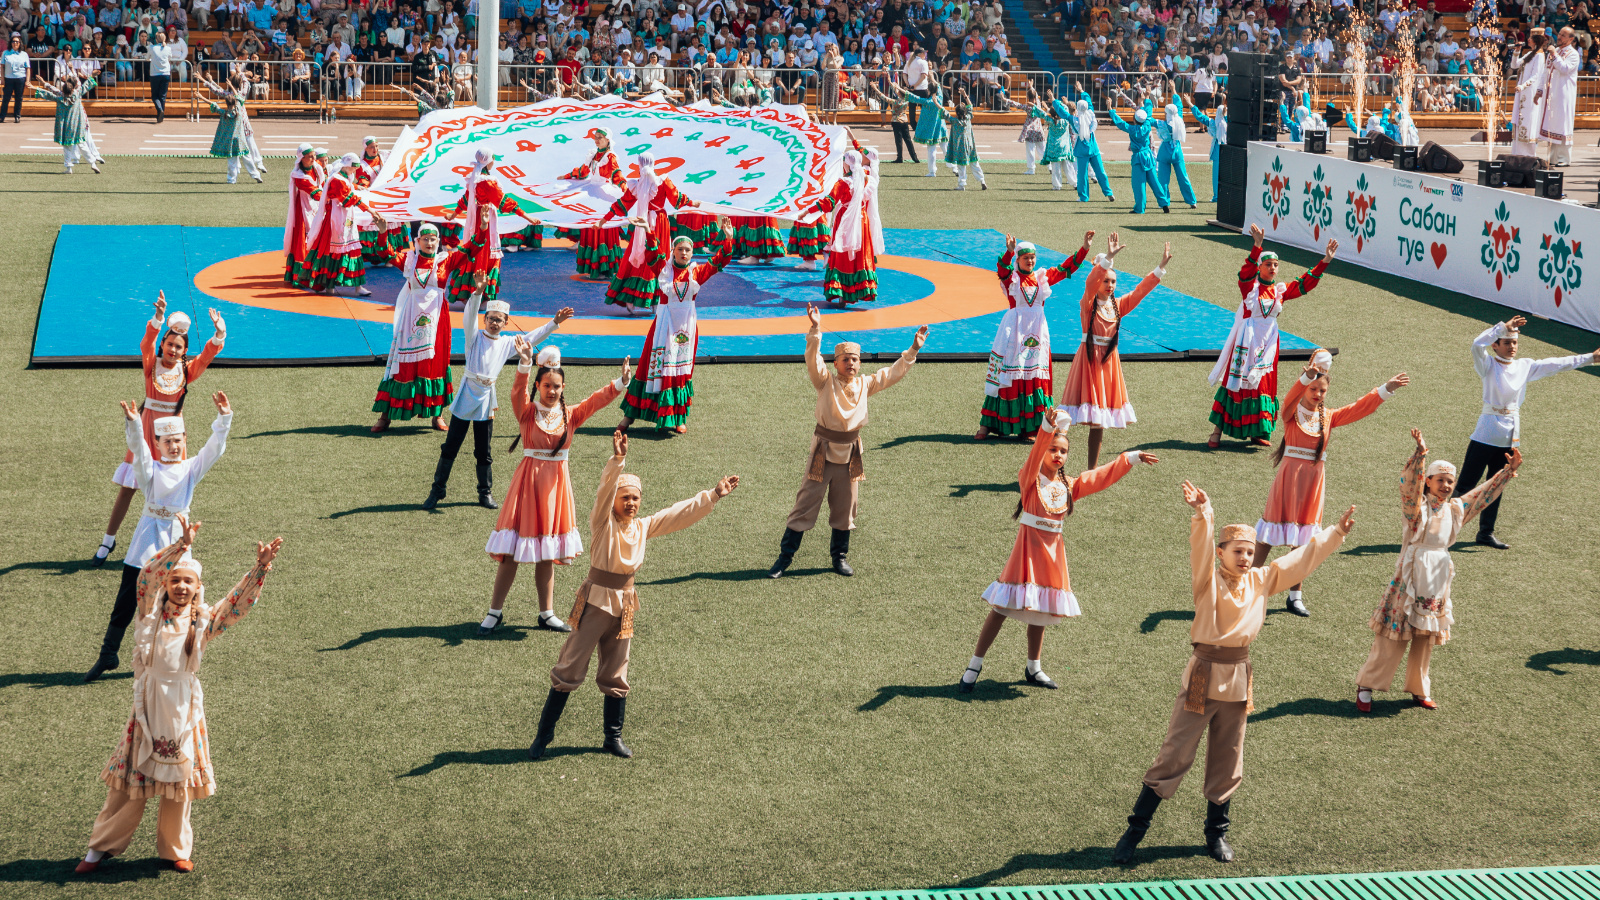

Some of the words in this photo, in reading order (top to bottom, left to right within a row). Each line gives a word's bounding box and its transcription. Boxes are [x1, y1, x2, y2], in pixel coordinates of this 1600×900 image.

[1423, 187, 1445, 196] TATNEFT
[1452, 184, 1463, 197] 2024
[1399, 197, 1456, 236] Сабан
[1397, 236, 1424, 265] туе
